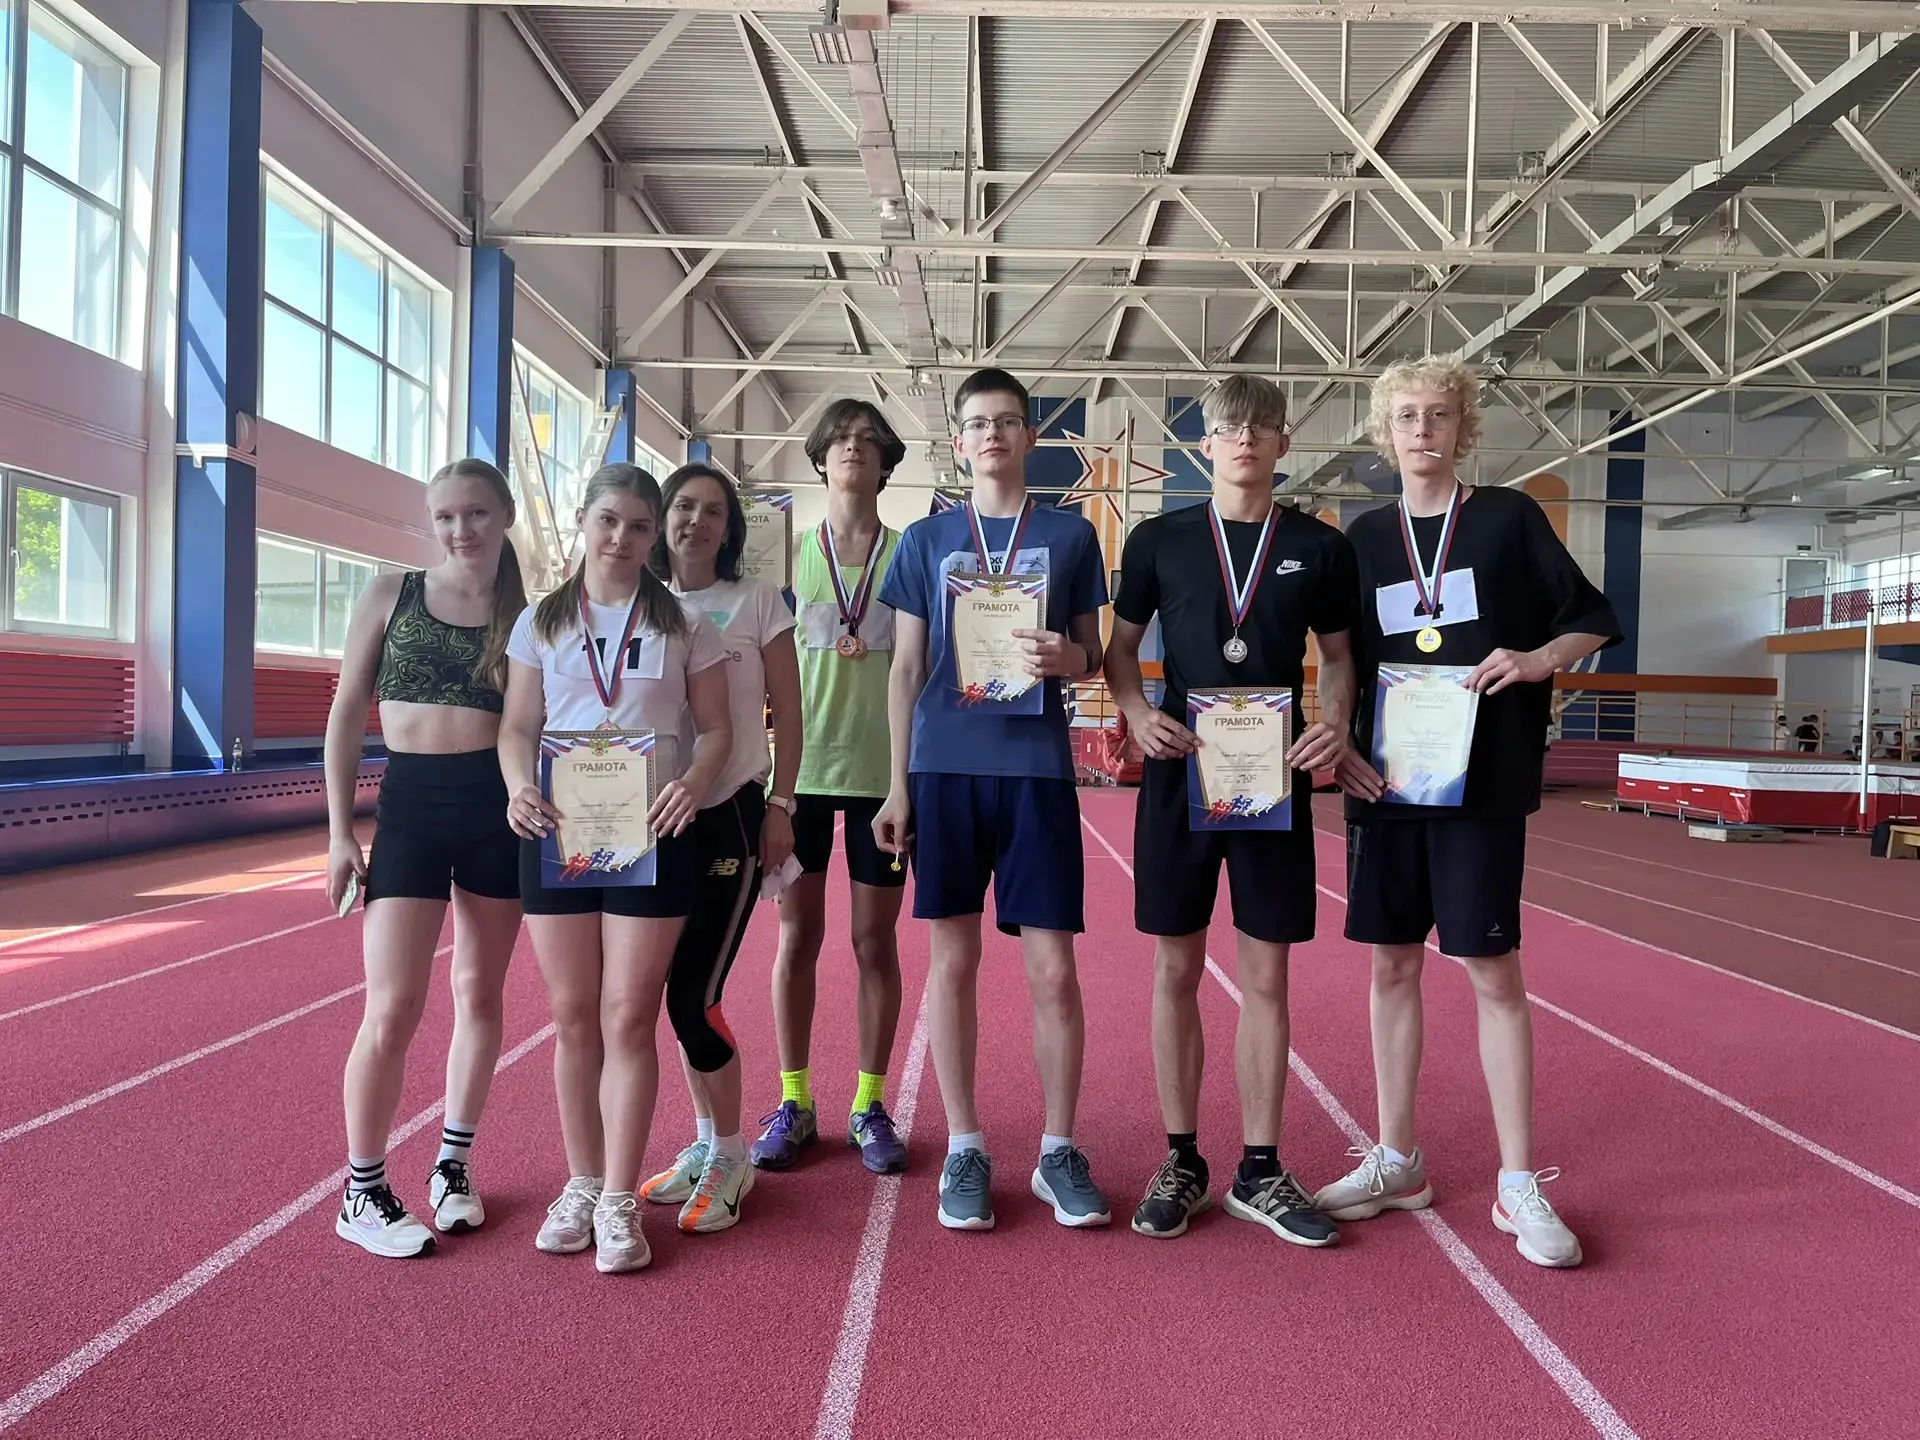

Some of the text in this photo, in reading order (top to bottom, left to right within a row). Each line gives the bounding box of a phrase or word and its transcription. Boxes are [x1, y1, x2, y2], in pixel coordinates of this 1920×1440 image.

[745, 515, 770, 523] МОТА
[1281, 559, 1303, 569] NIKE
[972, 602, 1020, 612] ГРАМОТА
[1214, 717, 1264, 727] ГРАМОТА
[573, 762, 627, 772] ГРАМОТА
